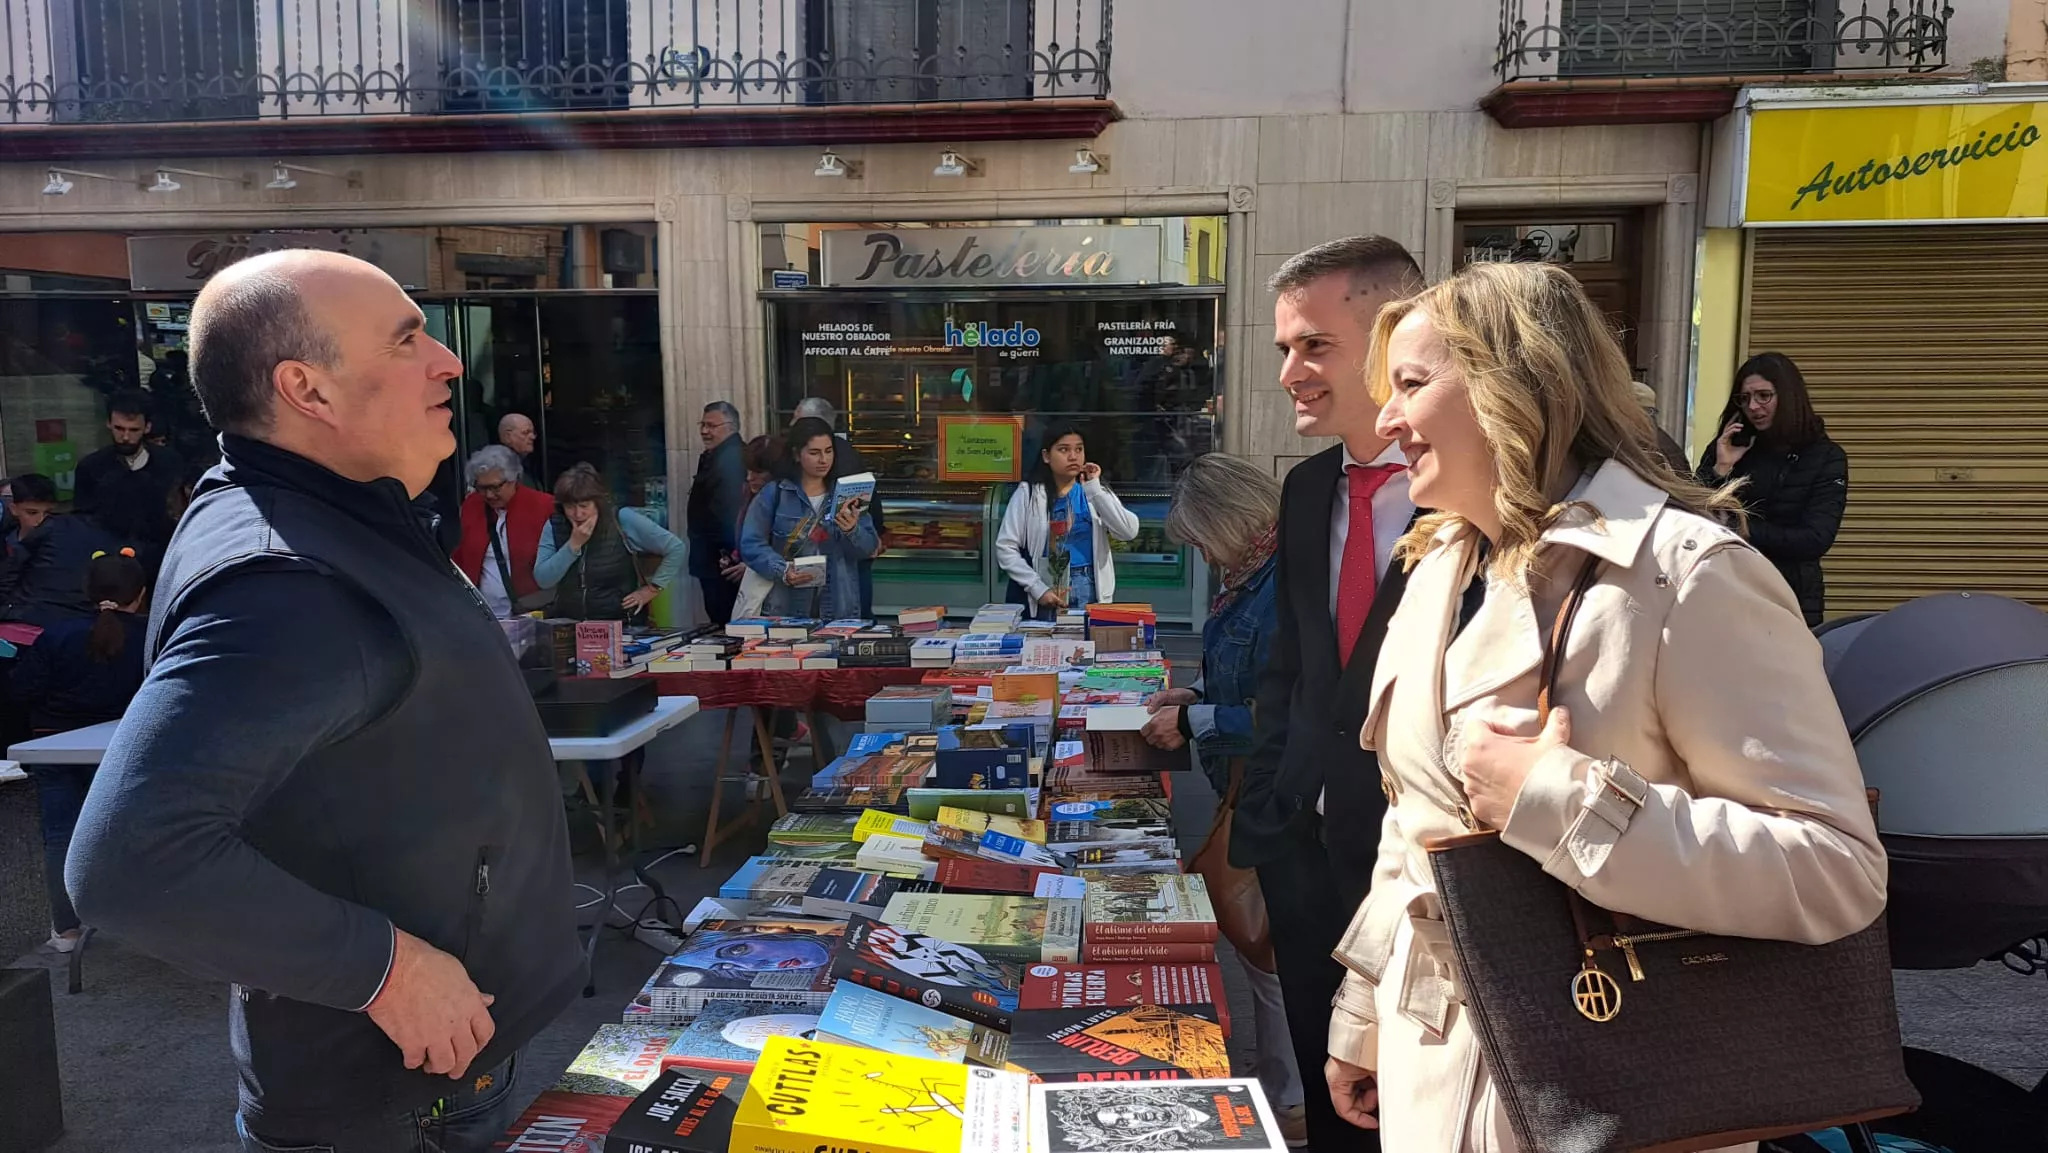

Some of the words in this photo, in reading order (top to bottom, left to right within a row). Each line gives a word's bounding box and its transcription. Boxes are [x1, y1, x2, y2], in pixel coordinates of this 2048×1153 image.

[1790, 121, 2042, 211] Autoservicio
[855, 229, 1115, 281] Pastelería
[801, 332, 844, 341] NUESTRO
[845, 333, 891, 341] OBRADOR
[818, 323, 860, 332] HELADOS
[862, 323, 874, 332] DE
[1098, 319, 1152, 331] PASTELERÍA
[1154, 319, 1176, 330] FRÍA
[804, 347, 848, 356] AFFOGATI
[850, 347, 862, 356] AL
[1103, 336, 1171, 346] GRANIZADOS
[1109, 346, 1165, 355] NATURALES
[1085, 969, 1107, 1000] GUERRA
[1047, 1023, 1084, 1041] JASON
[1084, 1009, 1118, 1028] LUTES
[1056, 1033, 1141, 1066] BERLIN
[766, 1048, 821, 1116] CUTTLAS
[646, 1102, 681, 1122] JOE
[666, 1077, 701, 1103] SACCO
